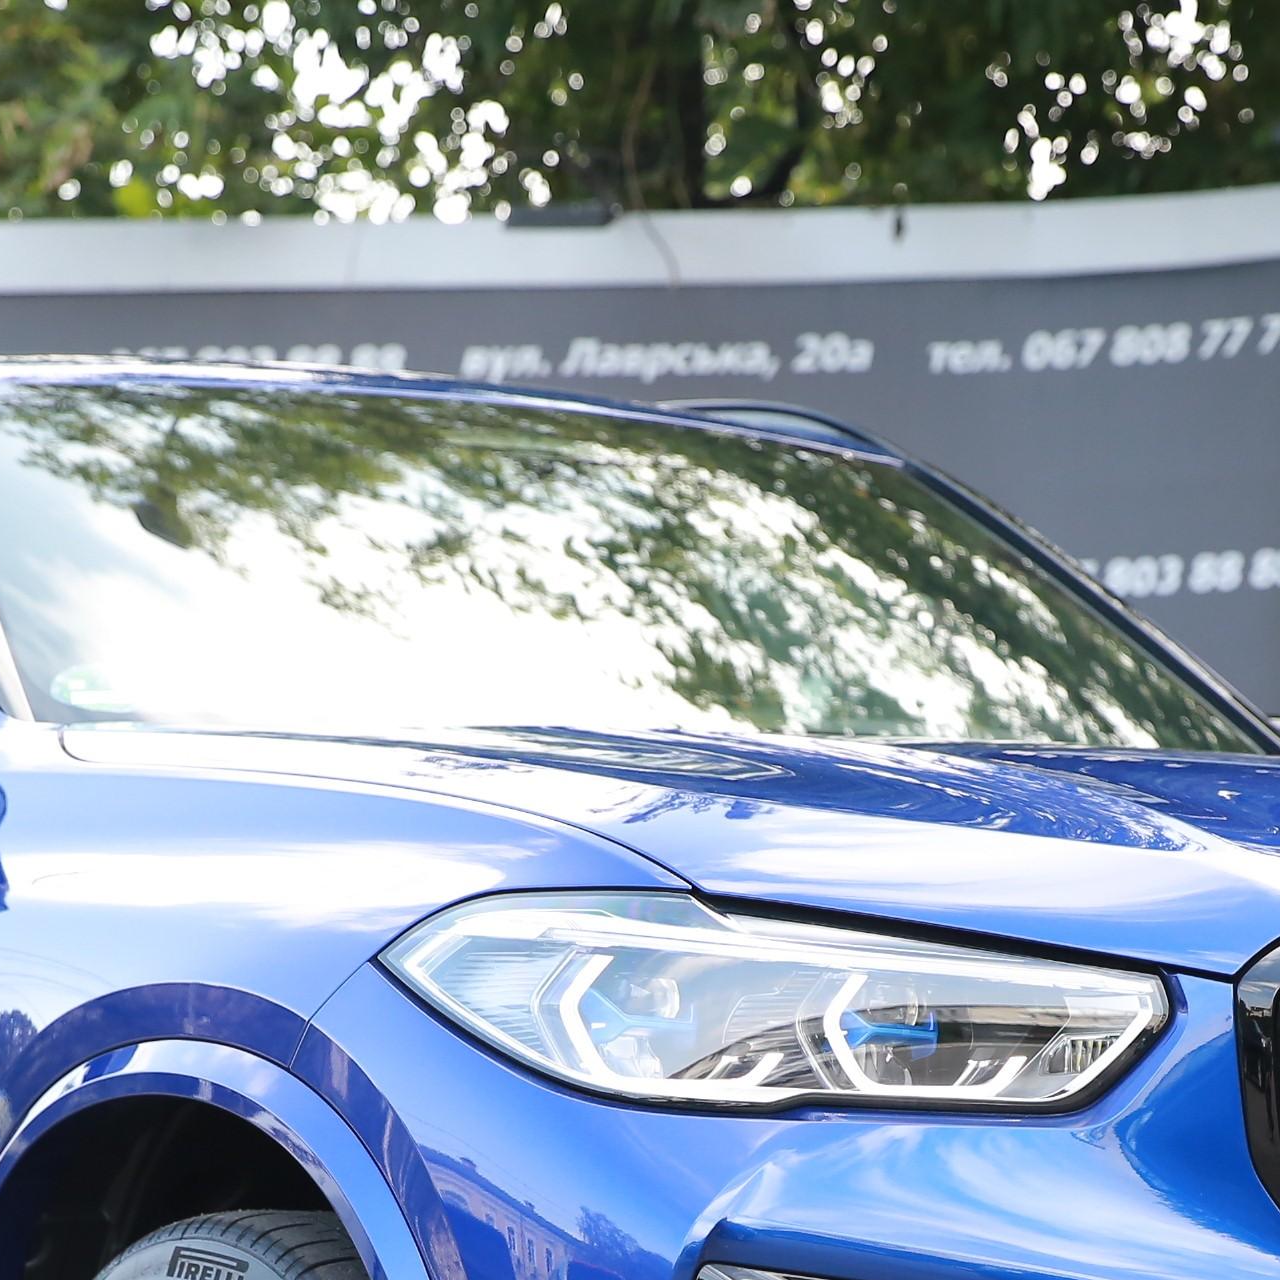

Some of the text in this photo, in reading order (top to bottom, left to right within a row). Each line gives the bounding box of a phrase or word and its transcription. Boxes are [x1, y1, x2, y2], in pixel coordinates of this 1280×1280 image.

[460, 344, 551, 385] вул.
[559, 337, 780, 384] Лаврська,
[927, 338, 1012, 374] тел.
[1021, 327, 1107, 372] 067
[1109, 321, 1192, 367] 808
[1197, 315, 1254, 360] 77
[1187, 551, 1245, 594] 88
